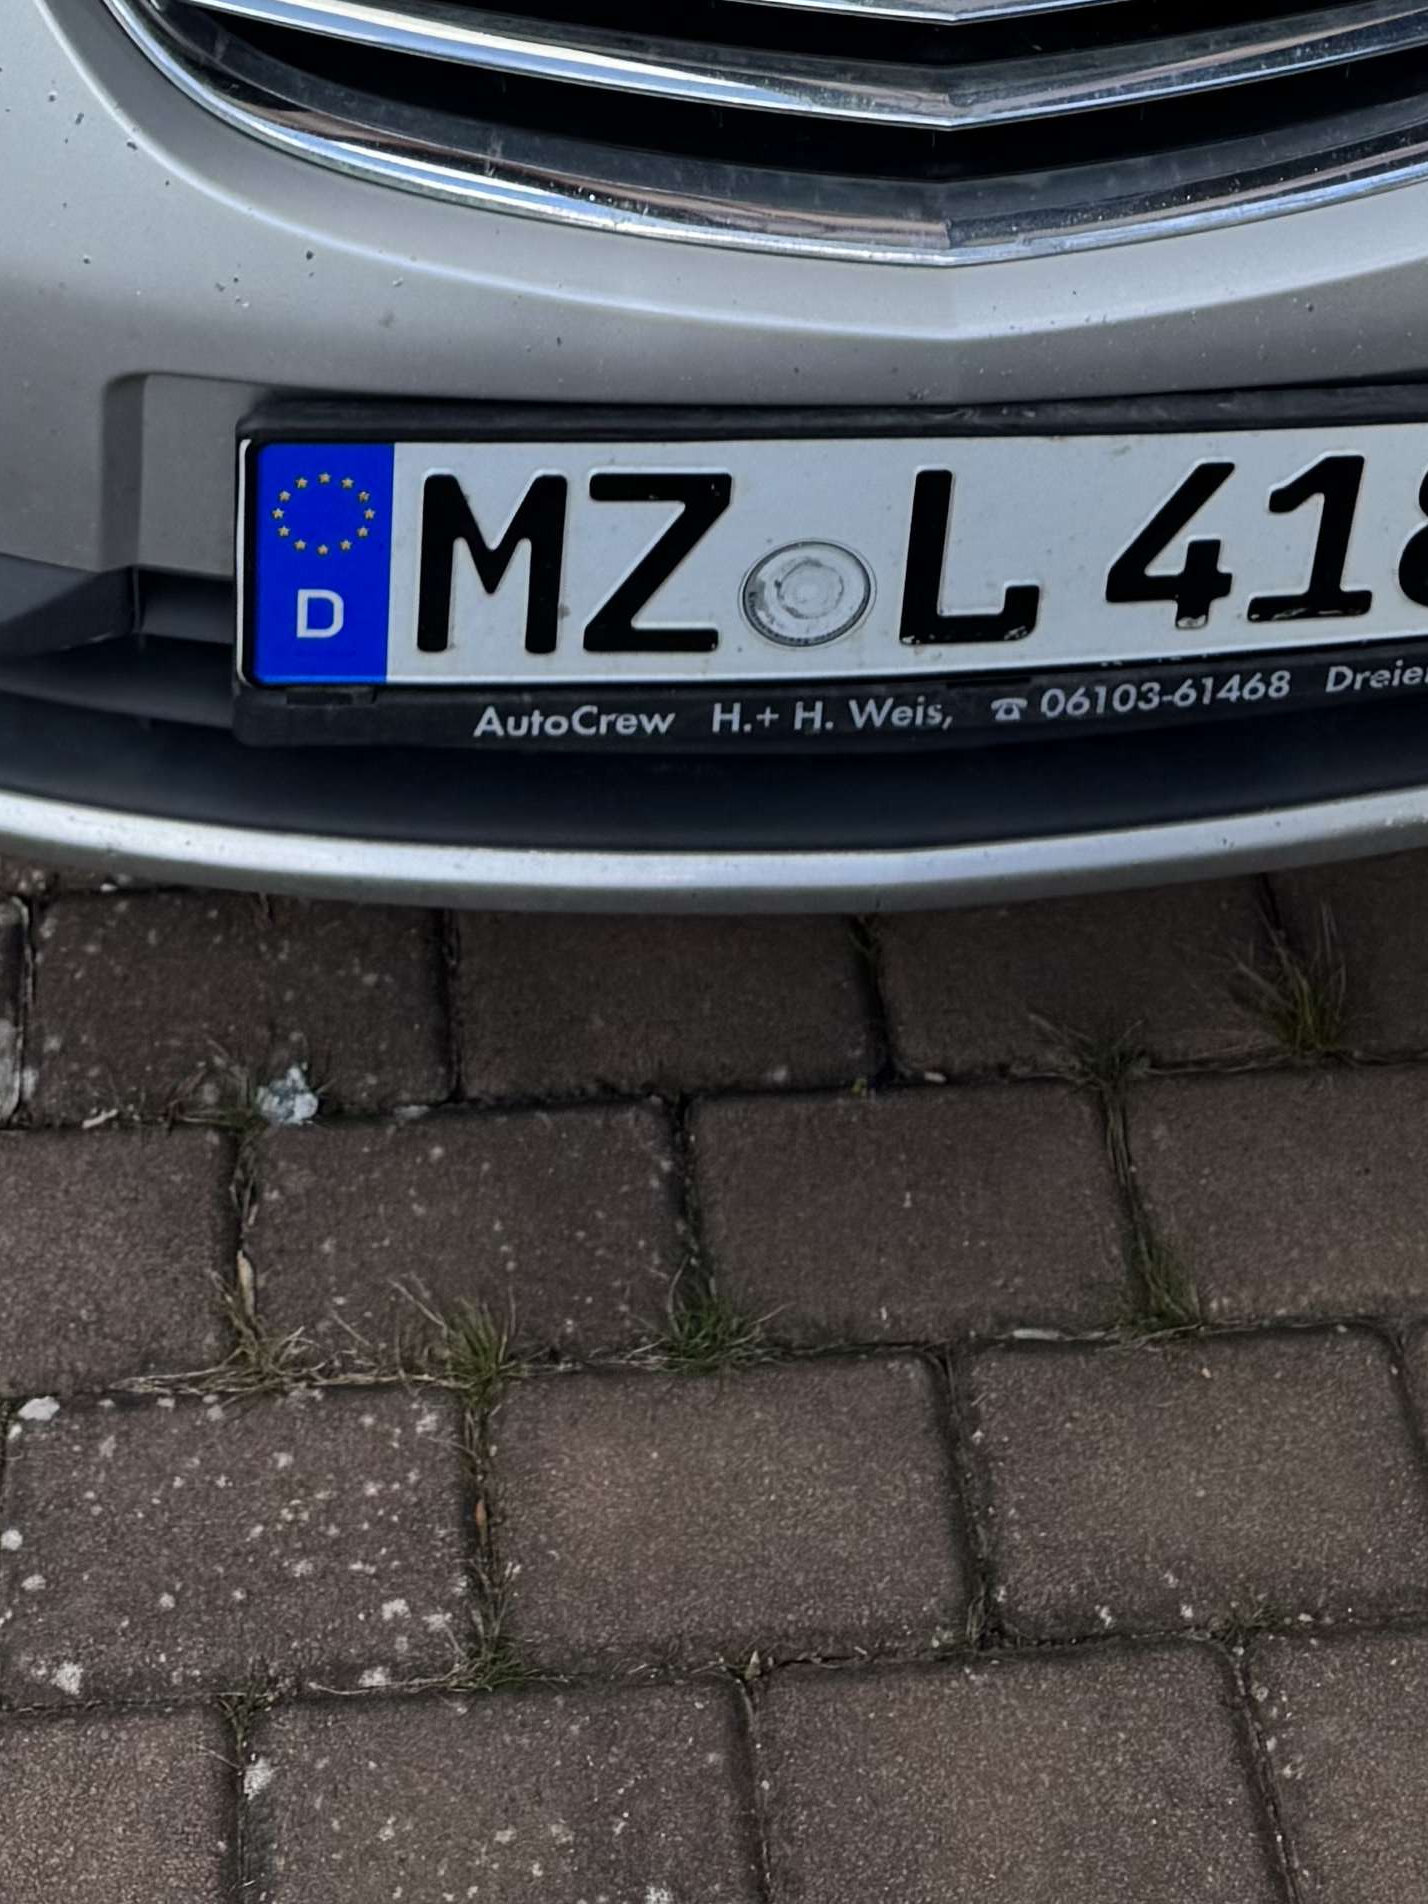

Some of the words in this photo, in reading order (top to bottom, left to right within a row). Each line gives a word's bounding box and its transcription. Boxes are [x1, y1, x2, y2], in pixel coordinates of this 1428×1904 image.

[417, 473, 734, 653] MZ
[899, 469, 1041, 645] L
[296, 589, 344, 638] D
[473, 705, 675, 738] AutoCrew
[794, 700, 834, 731] H.
[849, 696, 953, 730] Weis,
[1041, 670, 1290, 718] 06103-61468
